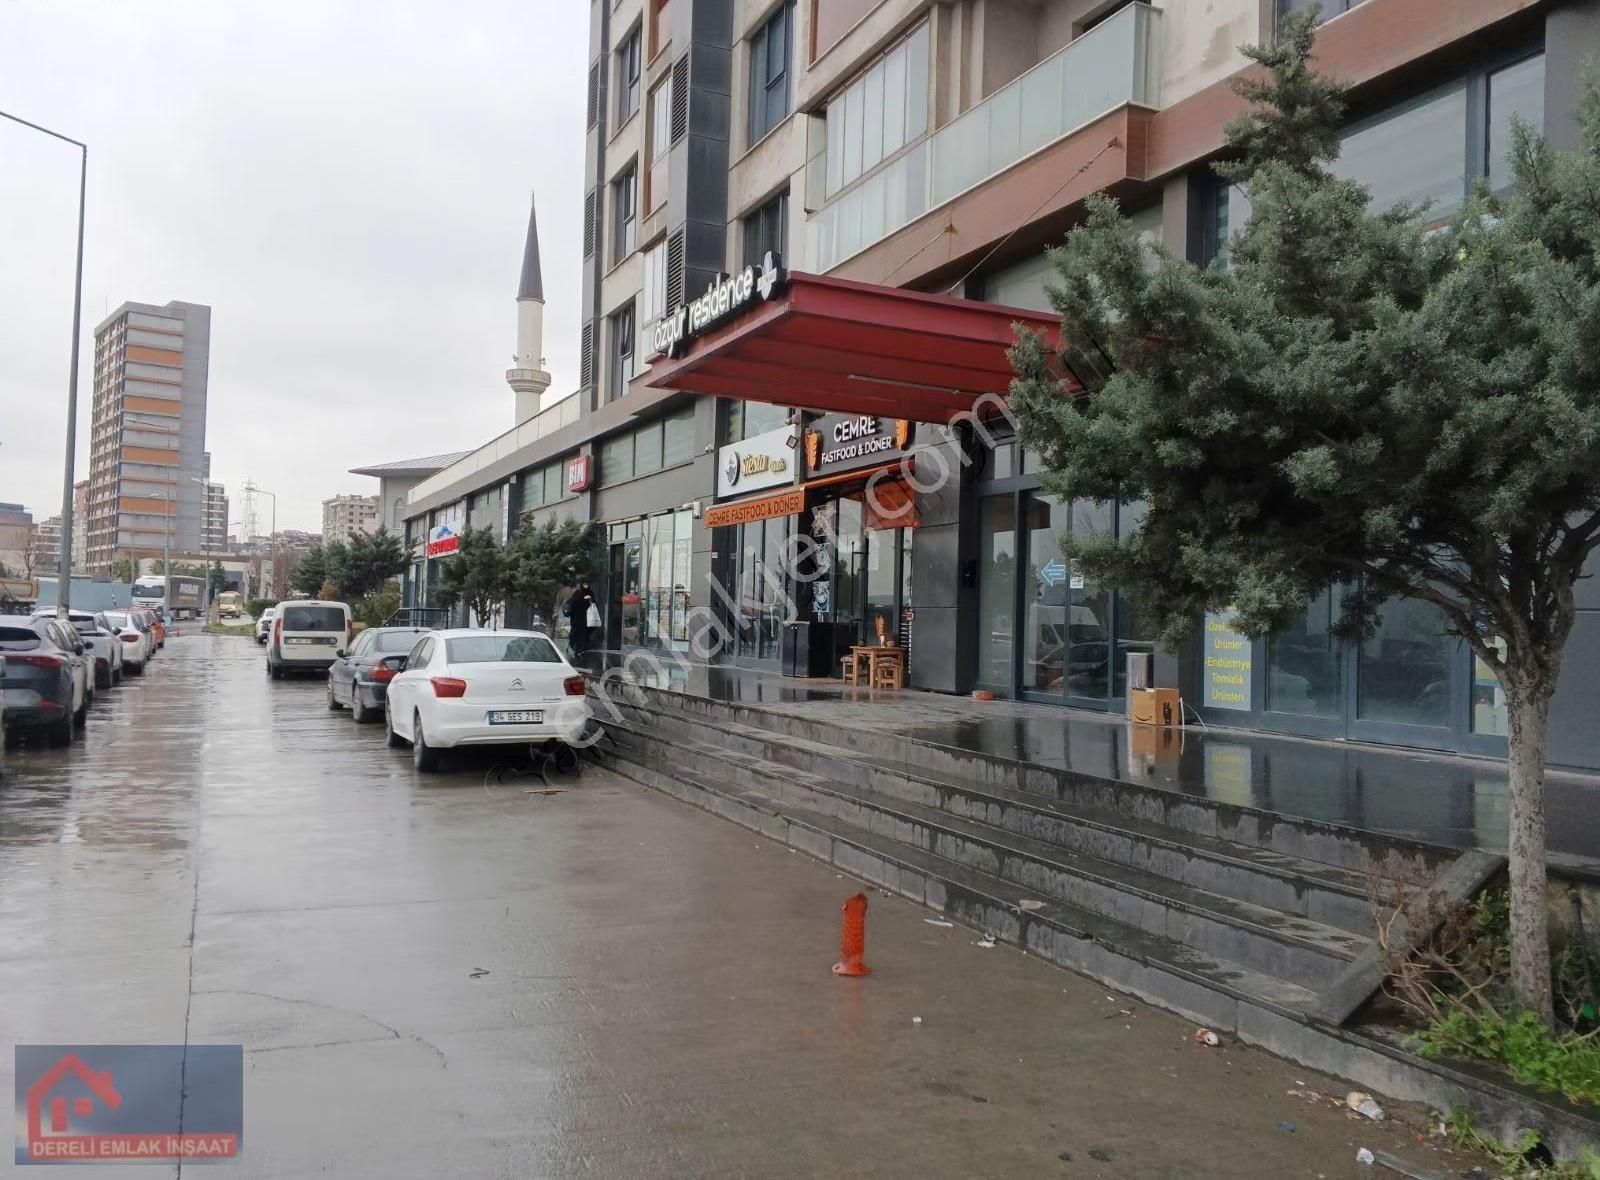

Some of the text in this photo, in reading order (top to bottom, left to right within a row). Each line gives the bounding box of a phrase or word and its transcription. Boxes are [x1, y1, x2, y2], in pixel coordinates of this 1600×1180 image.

[688, 264, 753, 335] residence
[833, 415, 876, 443] CEMRE
[821, 435, 892, 464] FASTFOOD & DÖNER
[709, 510, 730, 525] CEMRE
[731, 505, 766, 520] FASTFOOD
[767, 503, 772, 514] &
[494, 711, 540, 721] 34 GES 219
